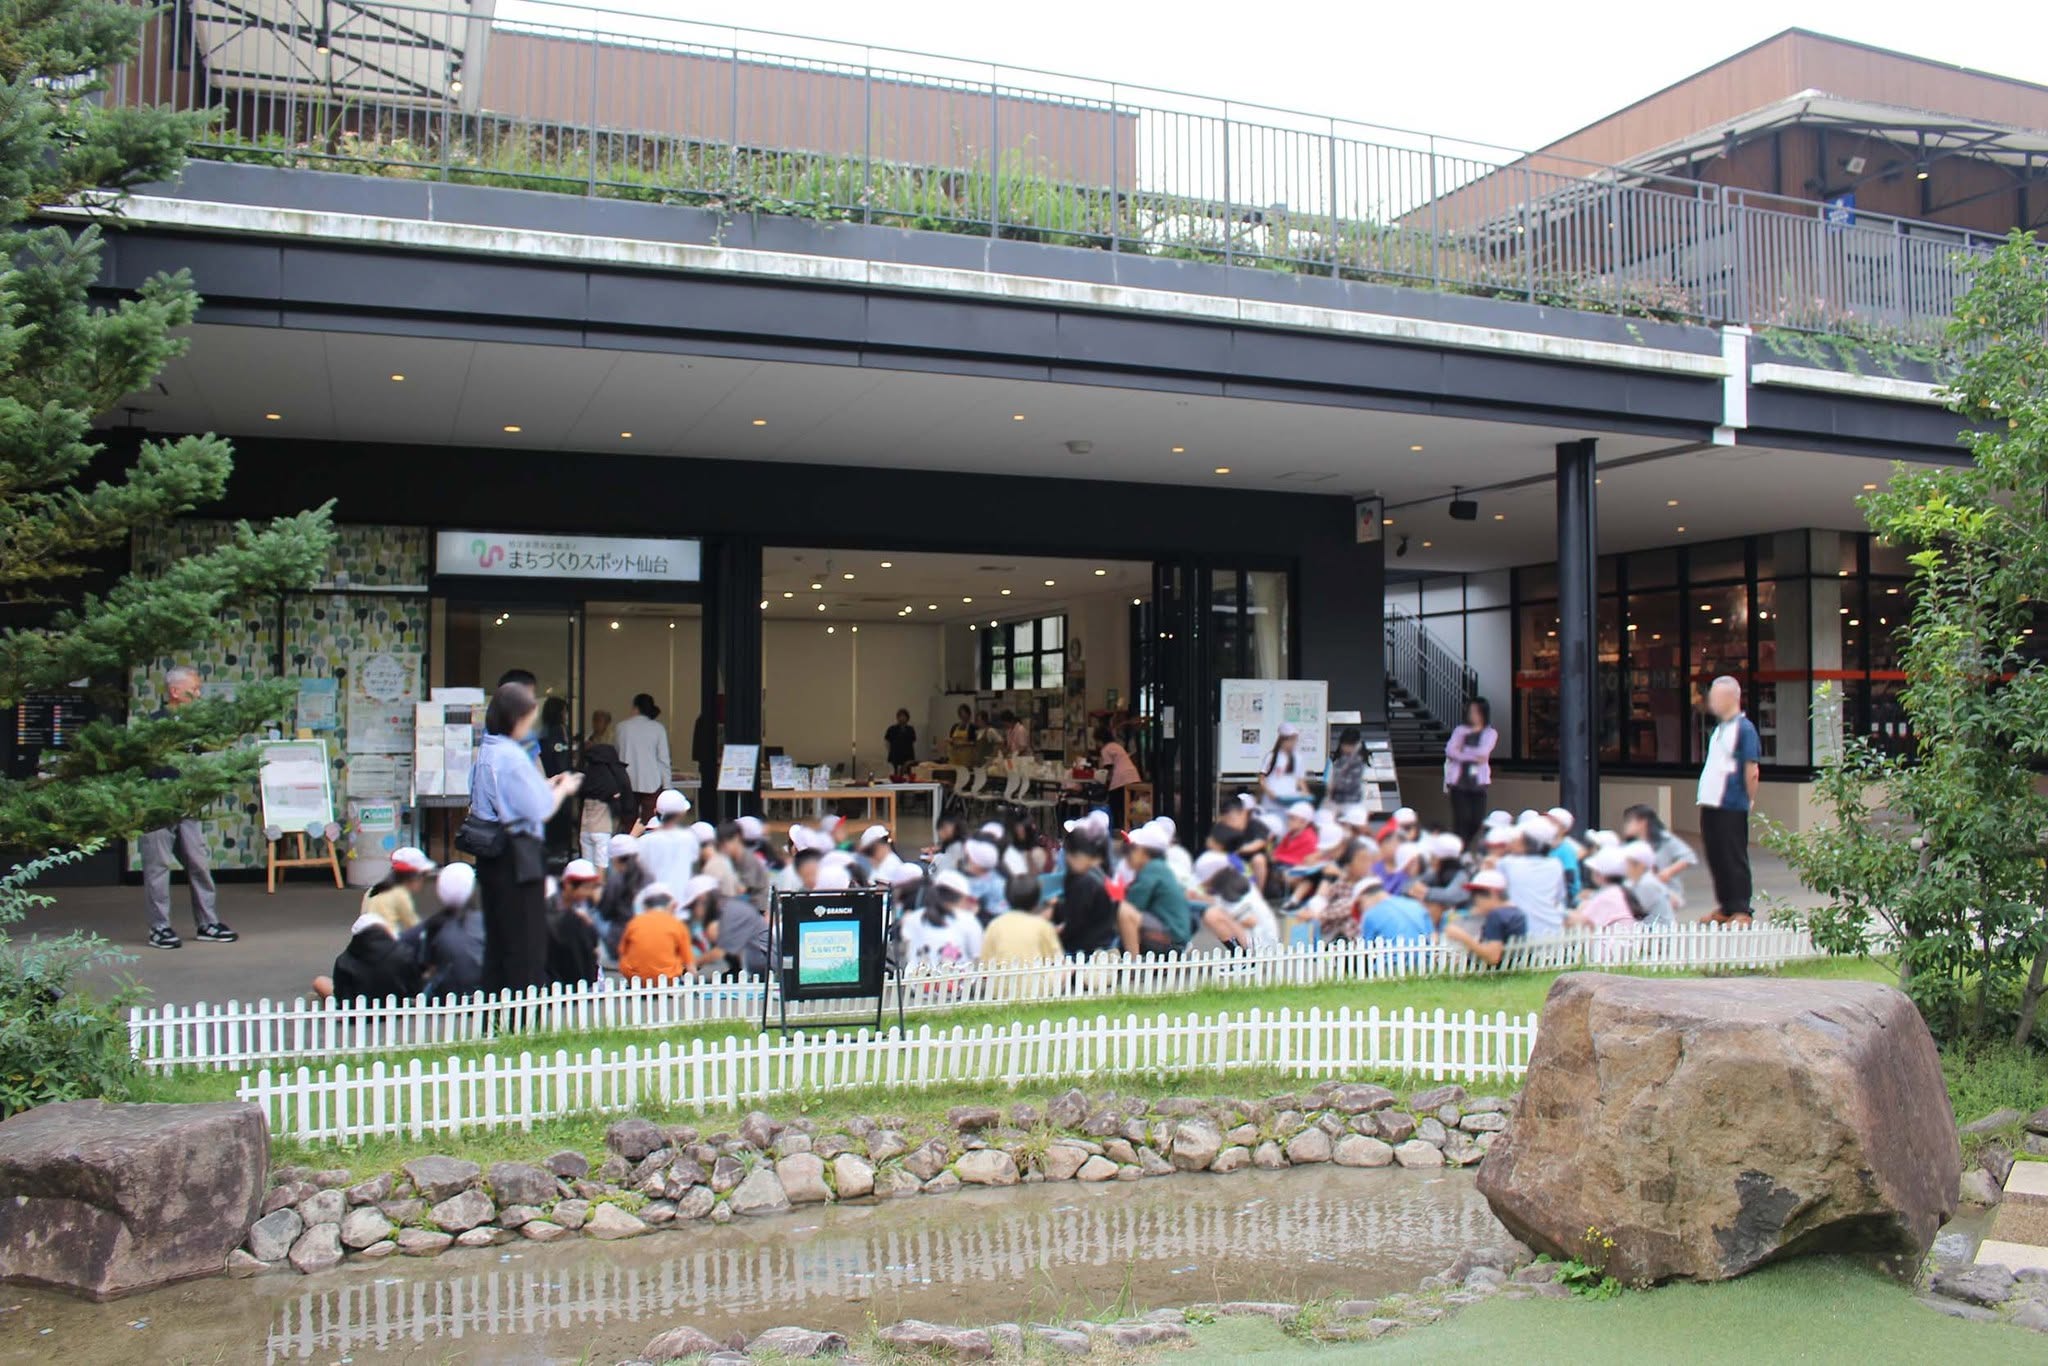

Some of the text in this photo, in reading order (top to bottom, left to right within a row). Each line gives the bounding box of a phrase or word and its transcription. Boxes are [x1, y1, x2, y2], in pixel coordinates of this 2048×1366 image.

[509, 551, 669, 573] まちづくりスポット仙台
